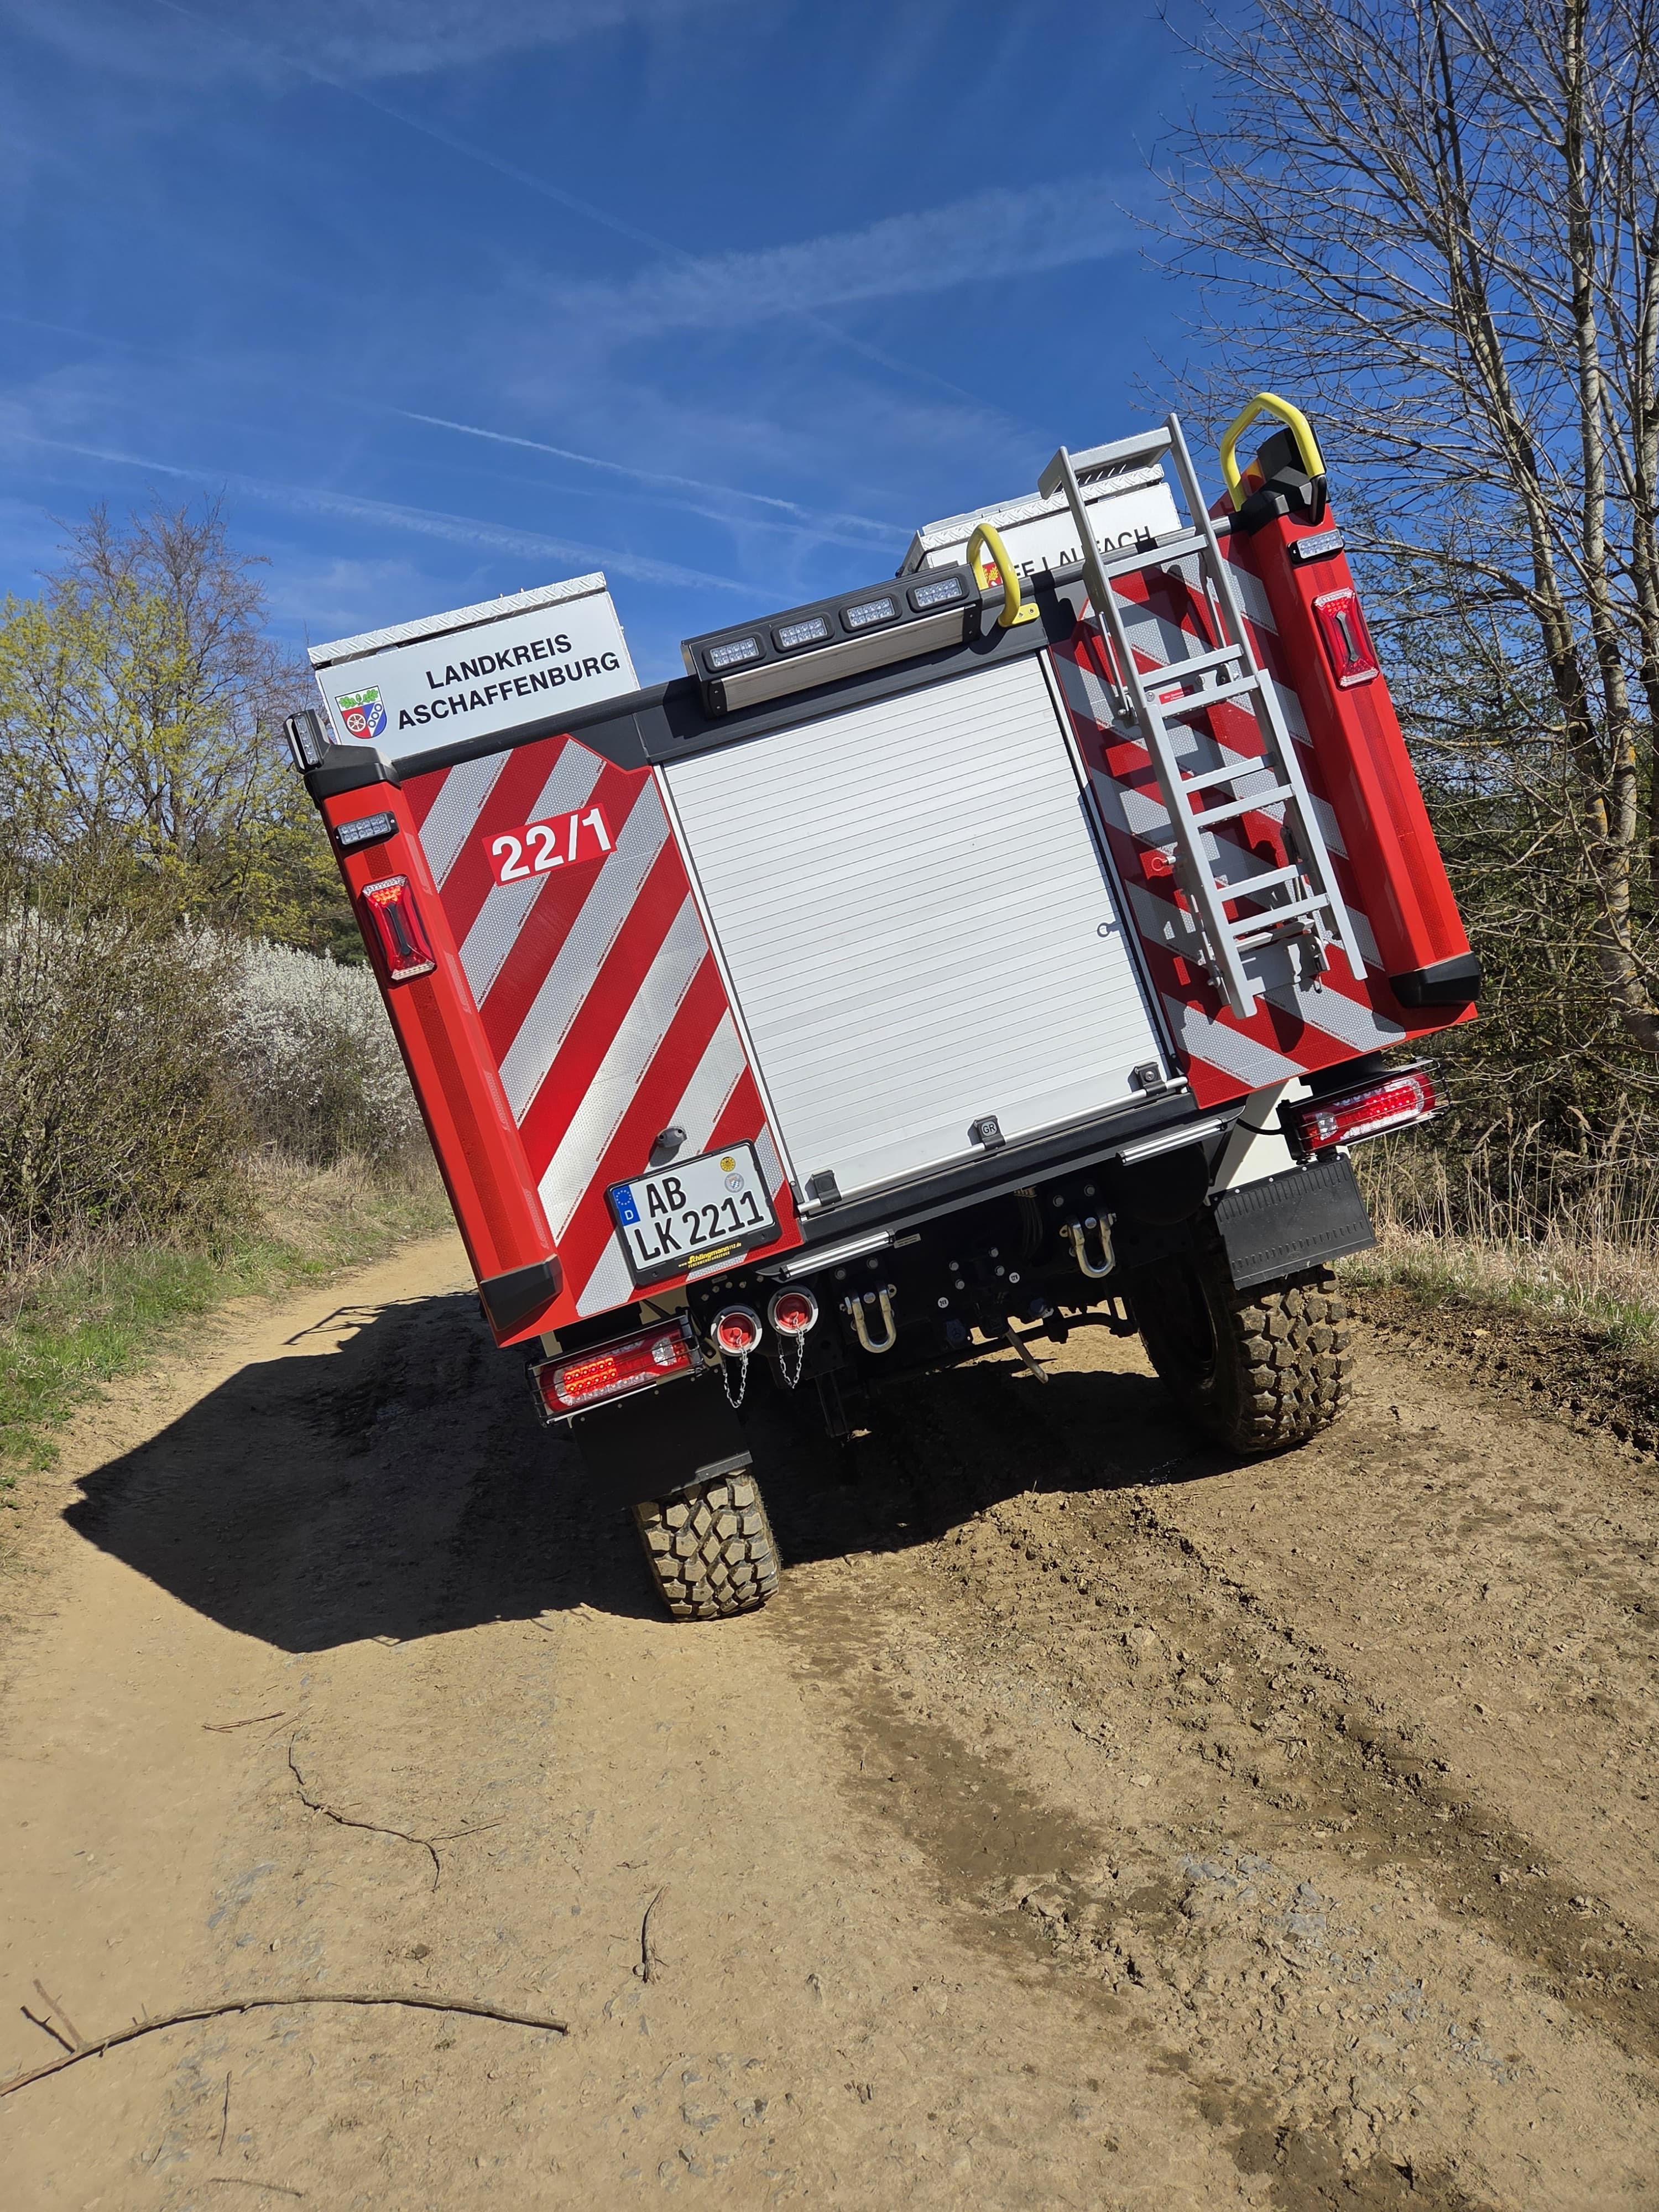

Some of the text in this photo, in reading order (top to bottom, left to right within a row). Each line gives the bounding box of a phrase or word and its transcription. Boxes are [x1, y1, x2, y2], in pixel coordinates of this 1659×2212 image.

[1042, 526, 1151, 570] LAACH
[426, 634, 572, 690] LANDKREIS
[399, 652, 620, 730] ASCHAFFENBURG
[492, 808, 612, 881] 22/1
[983, 1124, 996, 1134] GR
[625, 1210, 634, 1221] D
[646, 1177, 686, 1218] AB
[634, 1191, 764, 1261] LK 2211
